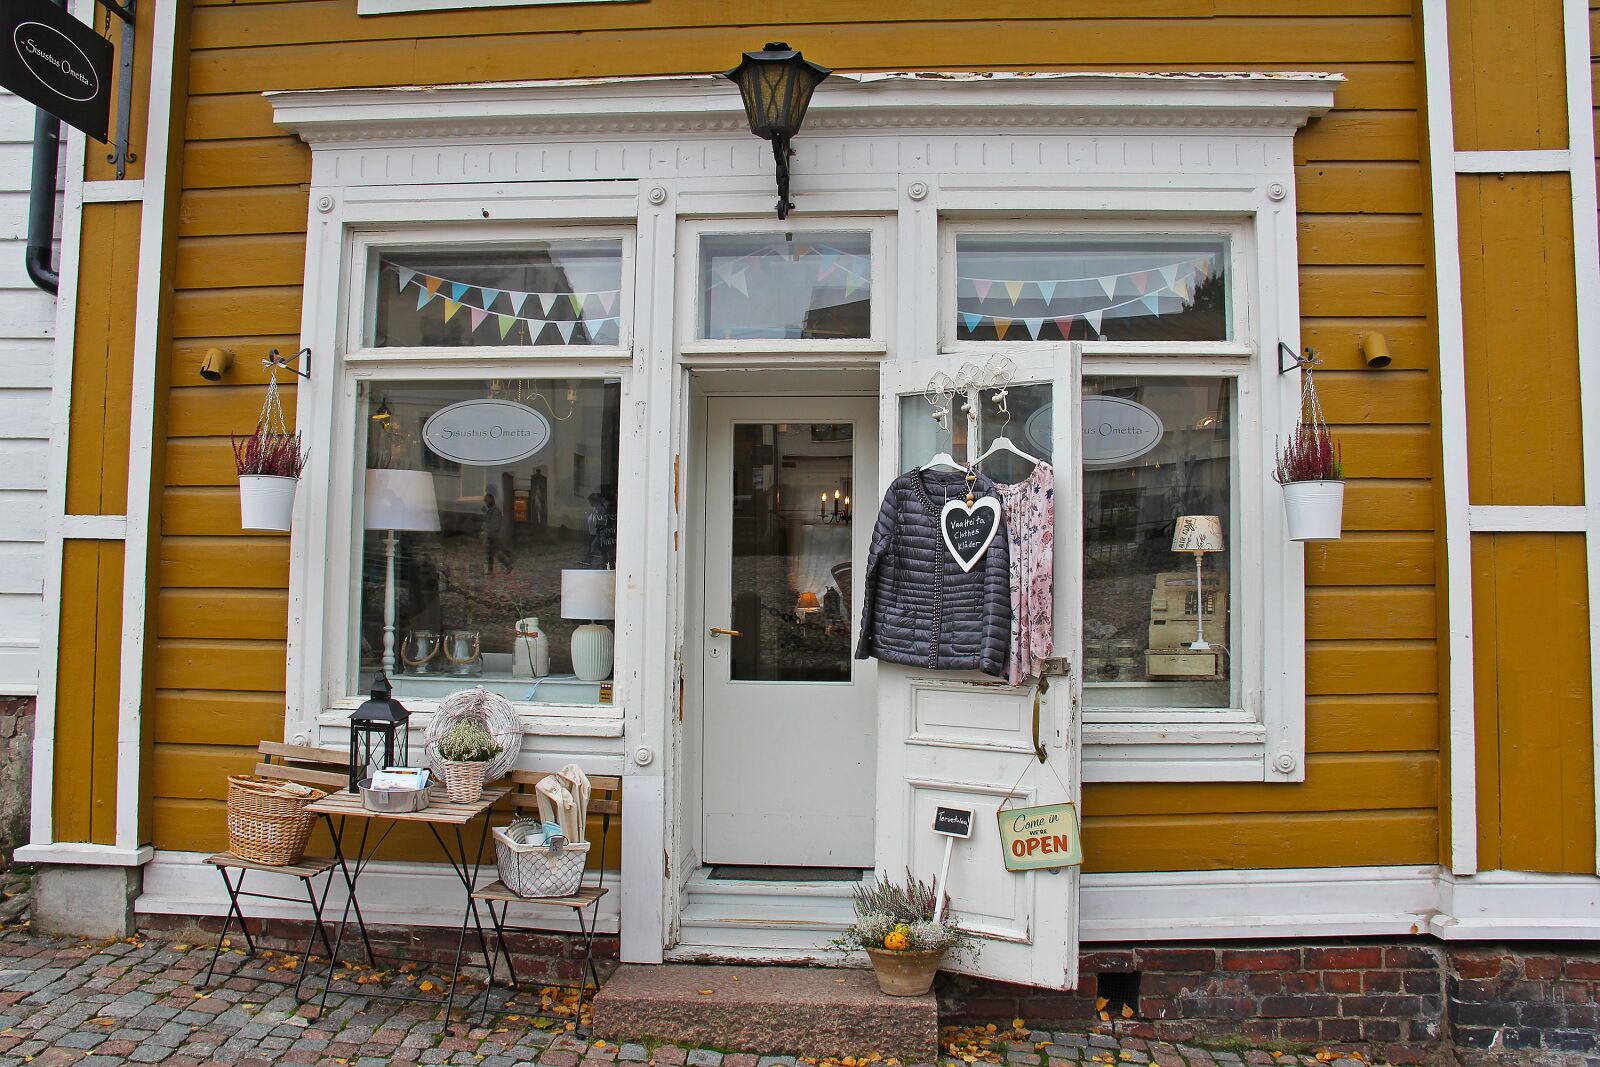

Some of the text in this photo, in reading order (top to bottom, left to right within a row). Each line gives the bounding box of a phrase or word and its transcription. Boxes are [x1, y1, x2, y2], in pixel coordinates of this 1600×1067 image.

[25, 38, 89, 86] Sisustus Ometta
[441, 425, 531, 440] Sisustus Ometta
[1099, 422, 1143, 437] Ometta
[953, 528, 980, 539] Clothes
[1013, 813, 1060, 833] Come in
[1011, 834, 1068, 857] OPEN
